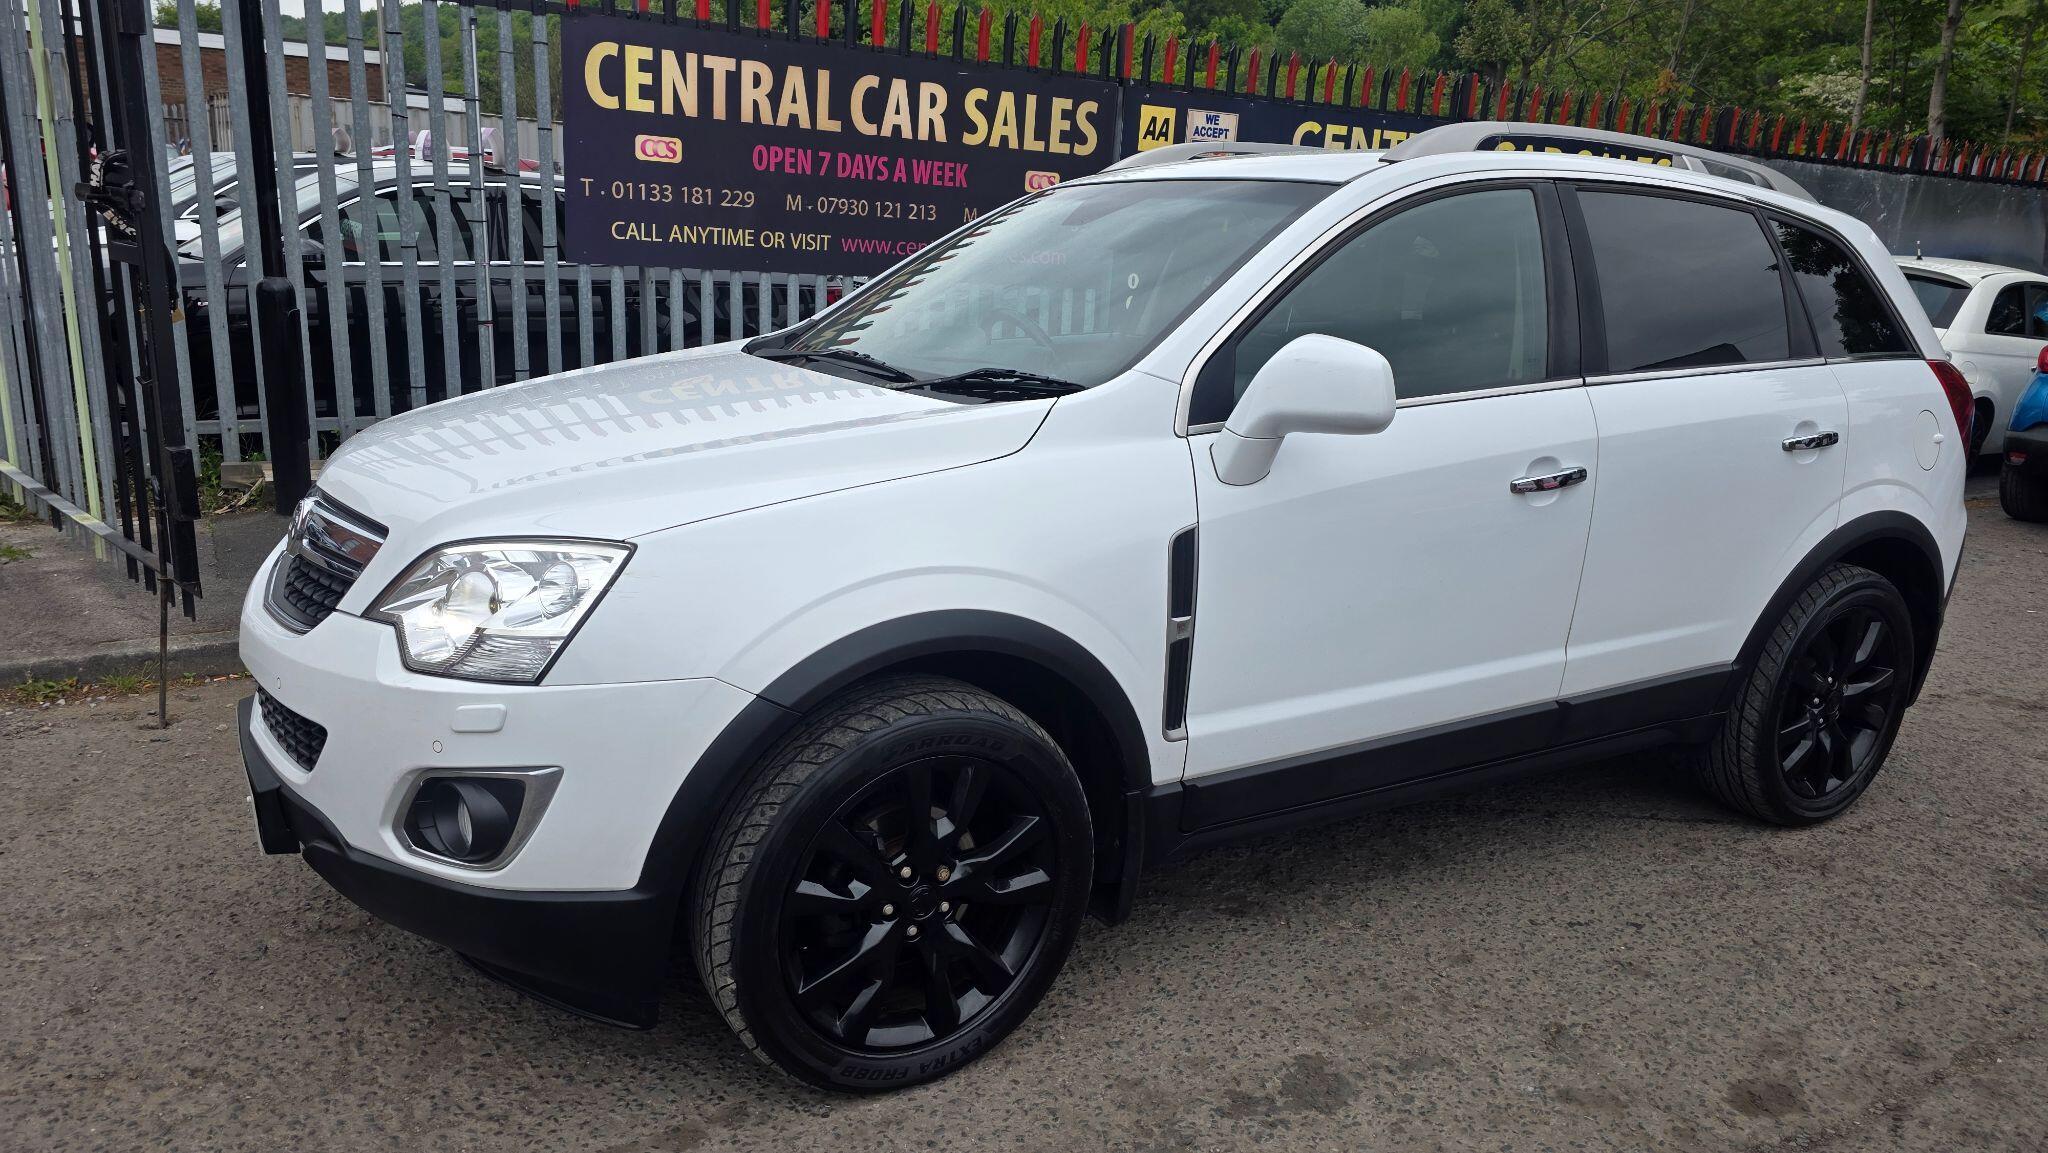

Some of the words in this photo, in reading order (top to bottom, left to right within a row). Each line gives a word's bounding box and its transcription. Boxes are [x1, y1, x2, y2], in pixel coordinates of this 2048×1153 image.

[584, 41, 842, 133] CENTRAL
[850, 74, 948, 143] CAR
[963, 87, 1099, 156] SALES
[1142, 116, 1170, 141] AA
[1205, 113, 1221, 126] WE
[1192, 126, 1230, 139] ACCEPT
[640, 139, 677, 159] CCS
[752, 144, 812, 174] OPEN
[818, 151, 831, 176] 7
[837, 153, 889, 181] DAYS
[893, 157, 907, 182] A
[912, 159, 969, 187] WEEK
[611, 181, 673, 203] 01133
[681, 186, 712, 206] 181
[720, 189, 755, 208] 229
[817, 196, 869, 217] 07930
[875, 201, 901, 219] 121
[908, 203, 937, 221] 213
[611, 221, 663, 242] CALL
[668, 224, 755, 247] ANYTIME
[759, 230, 785, 249] OR
[789, 232, 832, 251] VISIT
